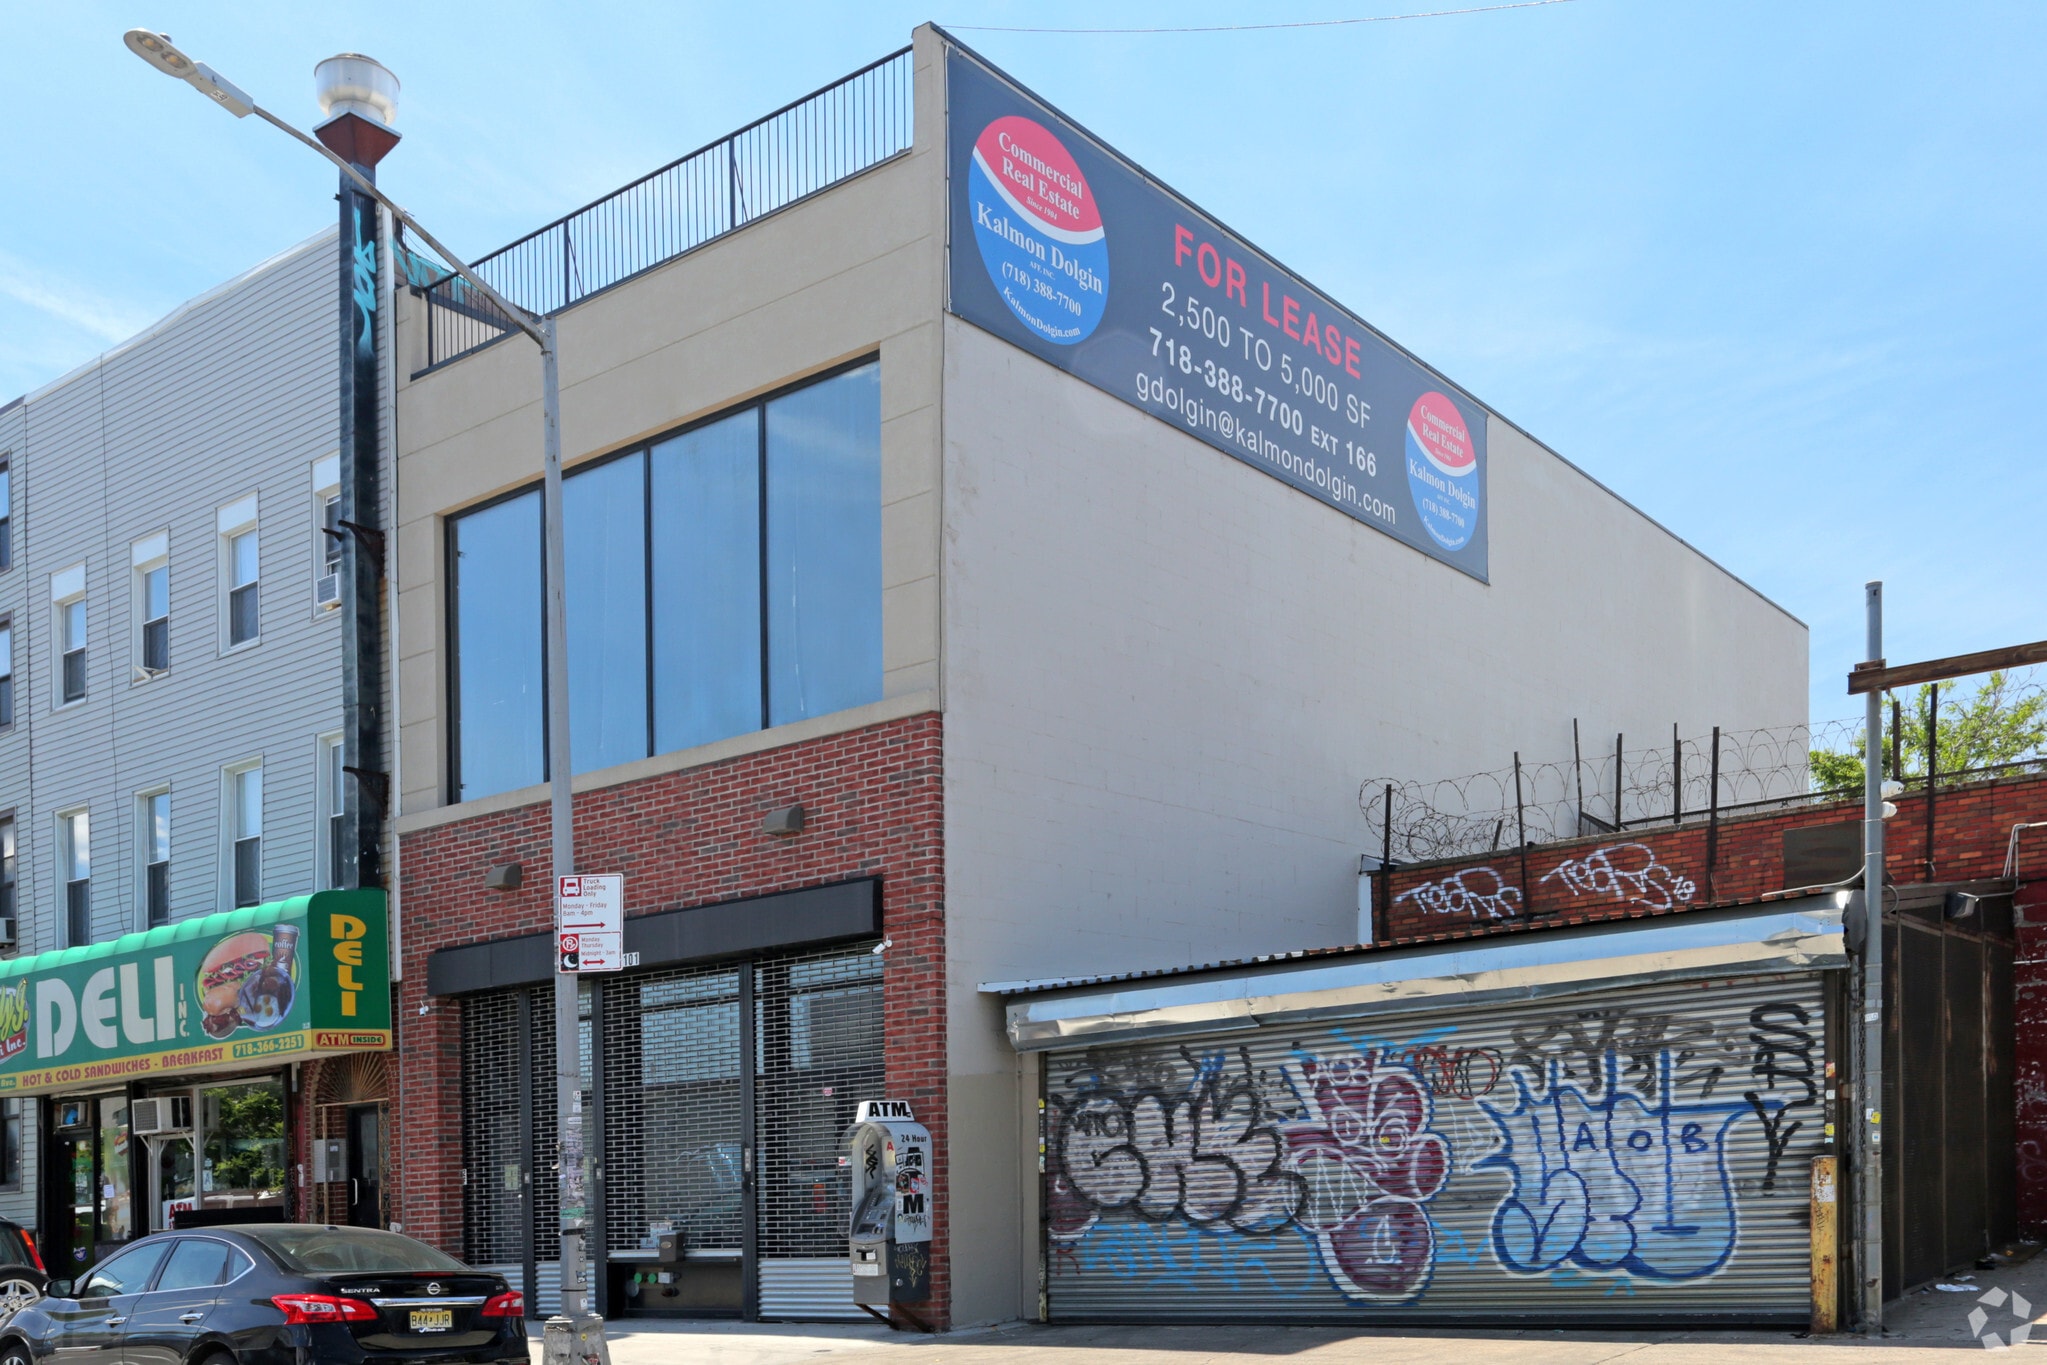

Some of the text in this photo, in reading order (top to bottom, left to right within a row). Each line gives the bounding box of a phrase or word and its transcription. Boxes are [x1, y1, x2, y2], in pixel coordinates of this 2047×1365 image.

[998, 131, 1083, 199] Commercial
[1002, 156, 1080, 220] Real Estate
[976, 200, 1103, 295] Kalmon Dolgin
[1002, 261, 1082, 317] (718) 388-7700
[1003, 285, 1081, 338] KalmonDolgin.com
[1174, 223, 1361, 380] FOR LEASE
[1161, 281, 1371, 429] 2,500 TO 5,000 SF
[1149, 327, 1377, 477] 718-388-7700 EXT 166
[1420, 404, 1466, 443] Commercial
[1135, 371, 1397, 525] gdolgin@kalmondolgin.com
[1422, 422, 1440, 446] Real
[1441, 434, 1465, 459] Estate
[1409, 458, 1476, 510] Kalmon Dolgin
[274, 938, 295, 950] coffee
[330, 913, 367, 1016] DELI
[36, 955, 178, 1059] DELI
[235, 1034, 303, 1056] 718-366-2251
[319, 1033, 383, 1046] ATM INSIDE
[22, 1073, 42, 1088] HOT
[44, 1071, 53, 1084] &
[55, 1067, 81, 1083] COLD
[84, 1057, 151, 1080] SANDWICHES
[161, 1047, 224, 1068] BREAKFAST
[868, 1102, 907, 1118] ATM
[901, 1134, 928, 1143] 24 Hour
